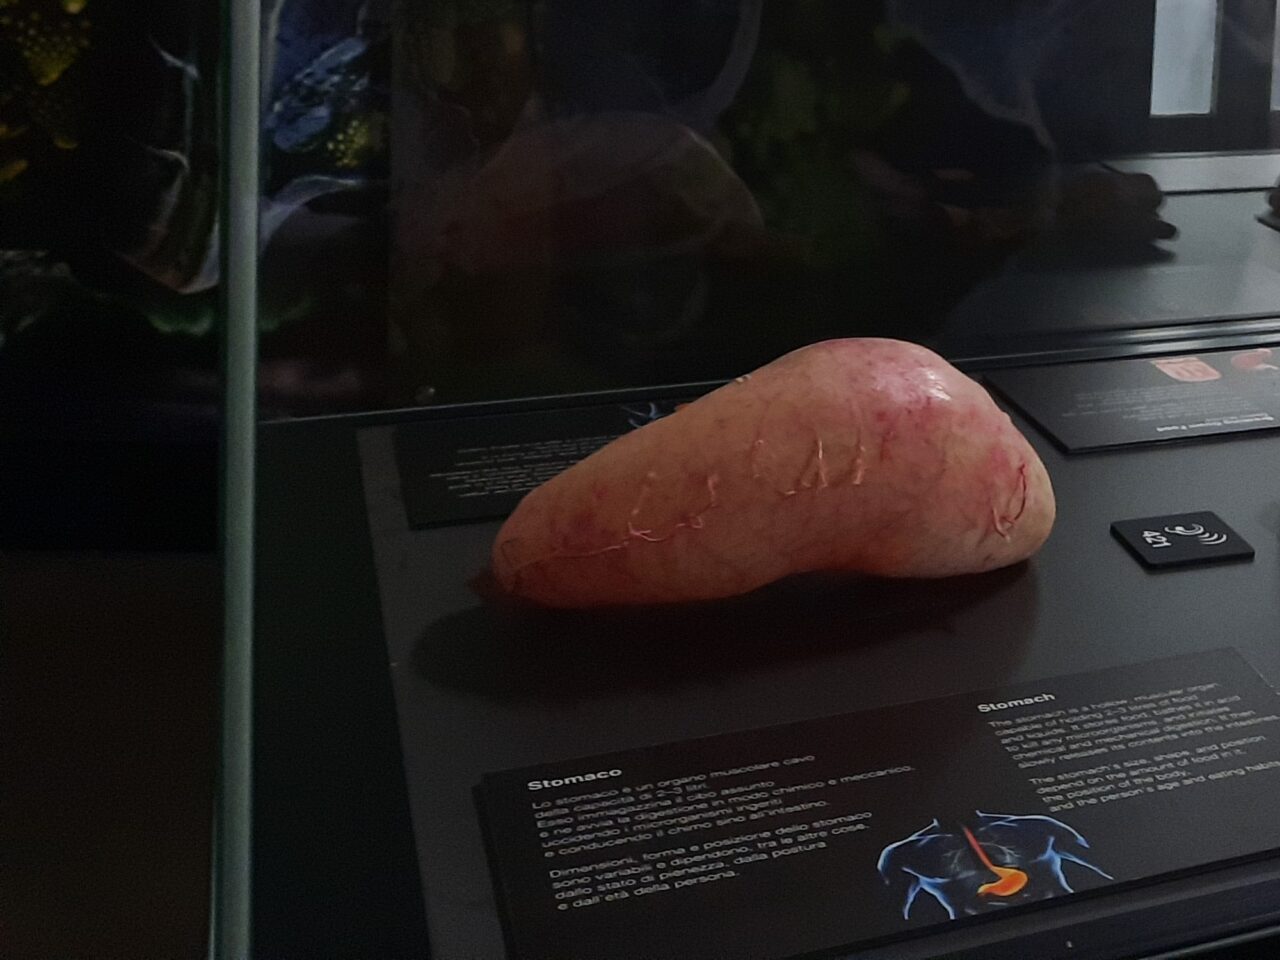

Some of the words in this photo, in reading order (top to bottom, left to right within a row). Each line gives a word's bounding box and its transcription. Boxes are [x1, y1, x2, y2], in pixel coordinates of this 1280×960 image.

[1141, 530, 1172, 548] 421
[977, 693, 1055, 712] Stomach
[527, 769, 621, 790] Stomaco
